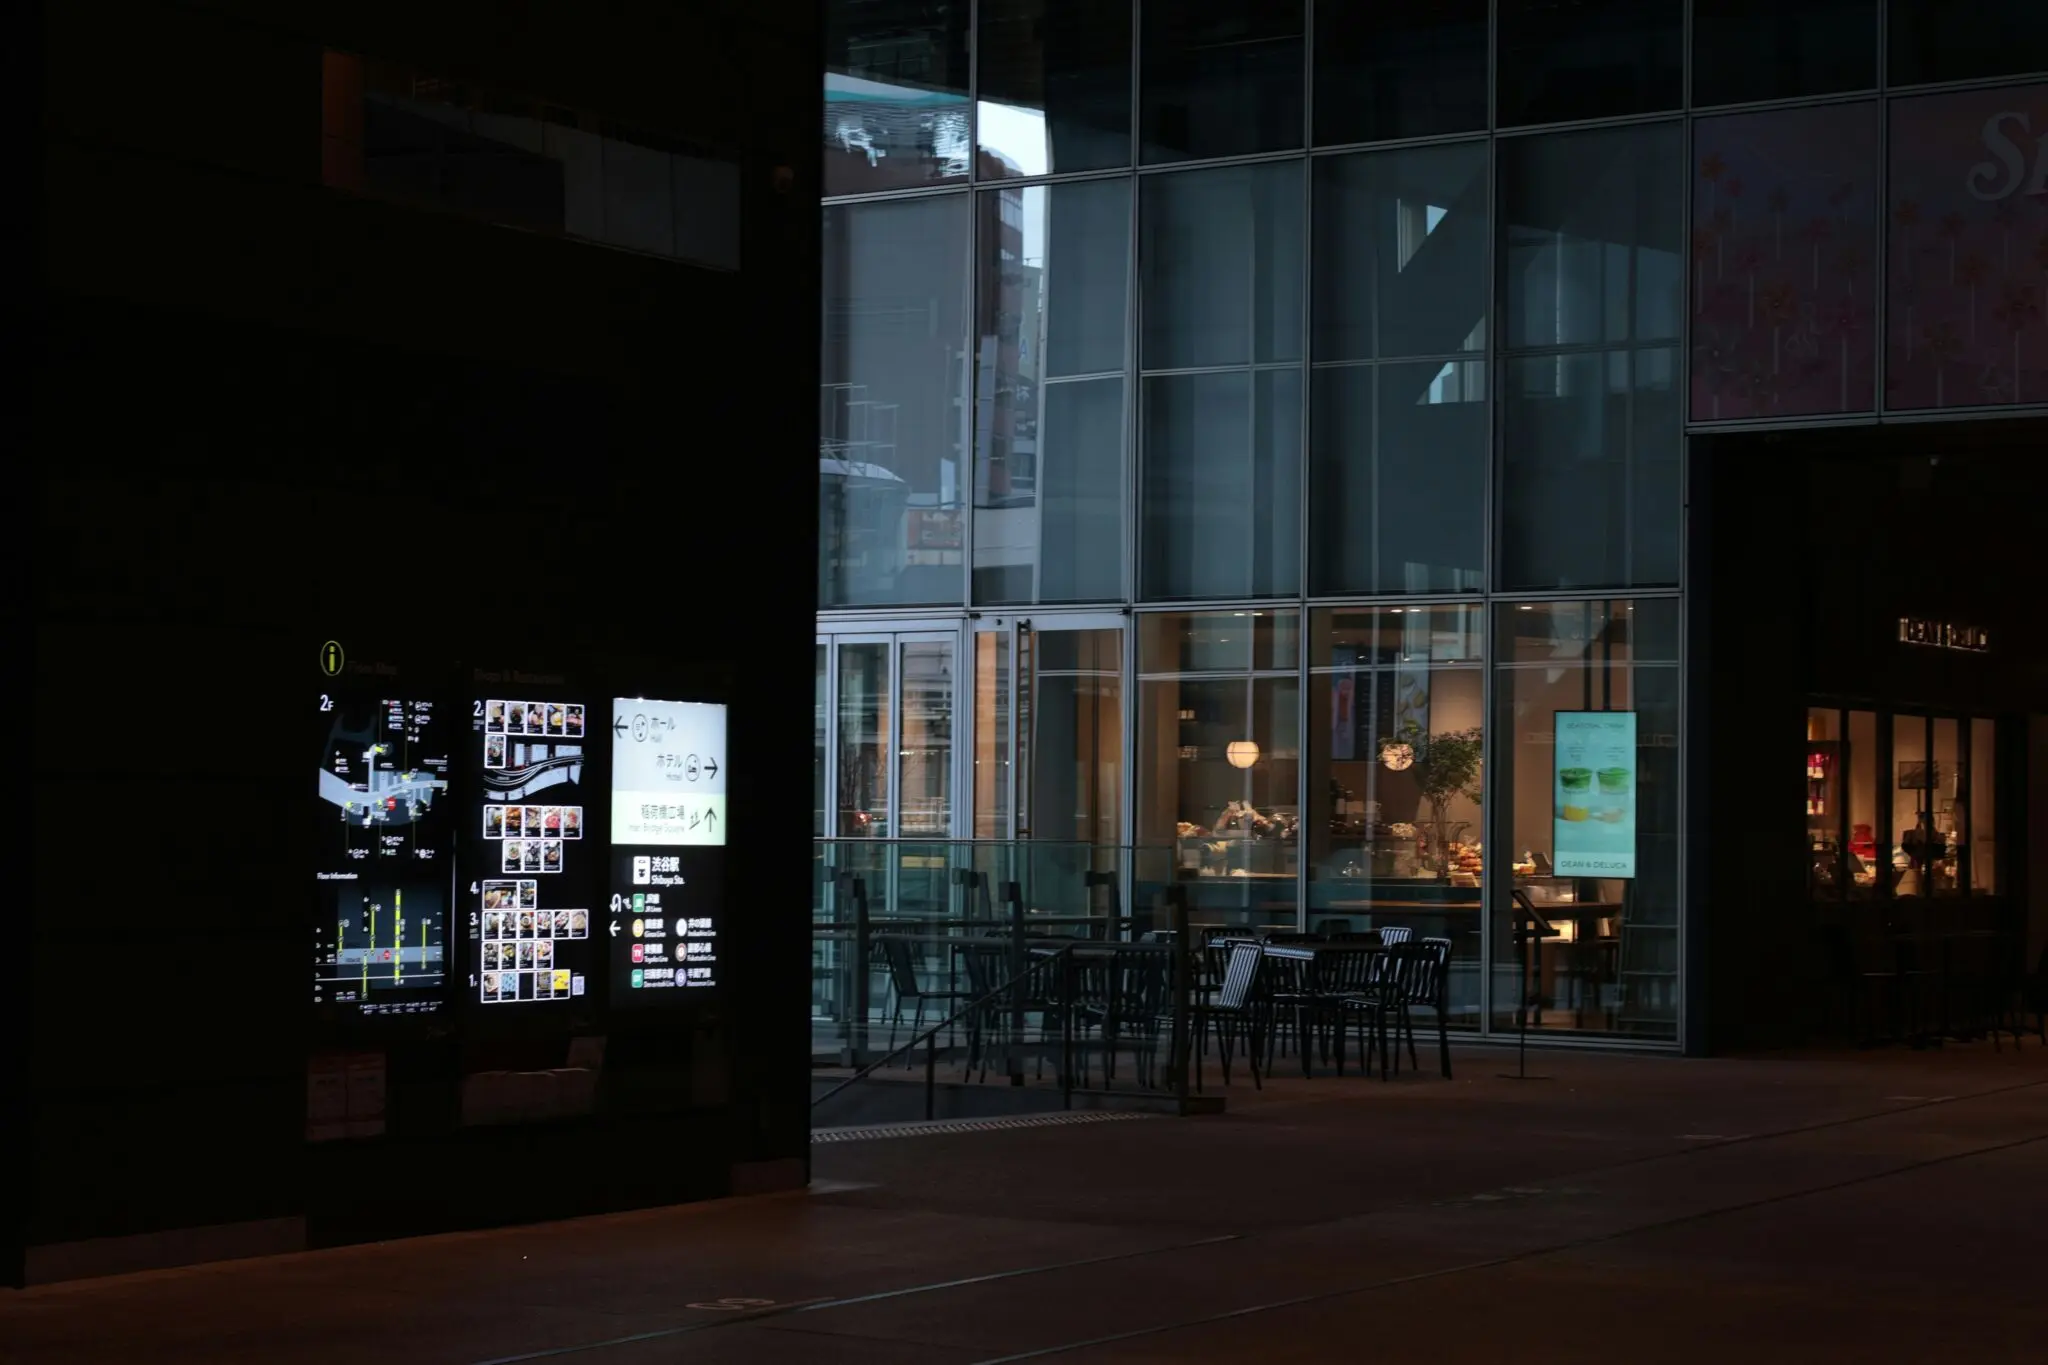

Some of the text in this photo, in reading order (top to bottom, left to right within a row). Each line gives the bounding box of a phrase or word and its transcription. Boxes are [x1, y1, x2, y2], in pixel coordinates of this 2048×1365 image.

[1967, 110, 2048, 201] S
[656, 754, 683, 768] ホテル
[652, 857, 679, 872] 渋谷駅
